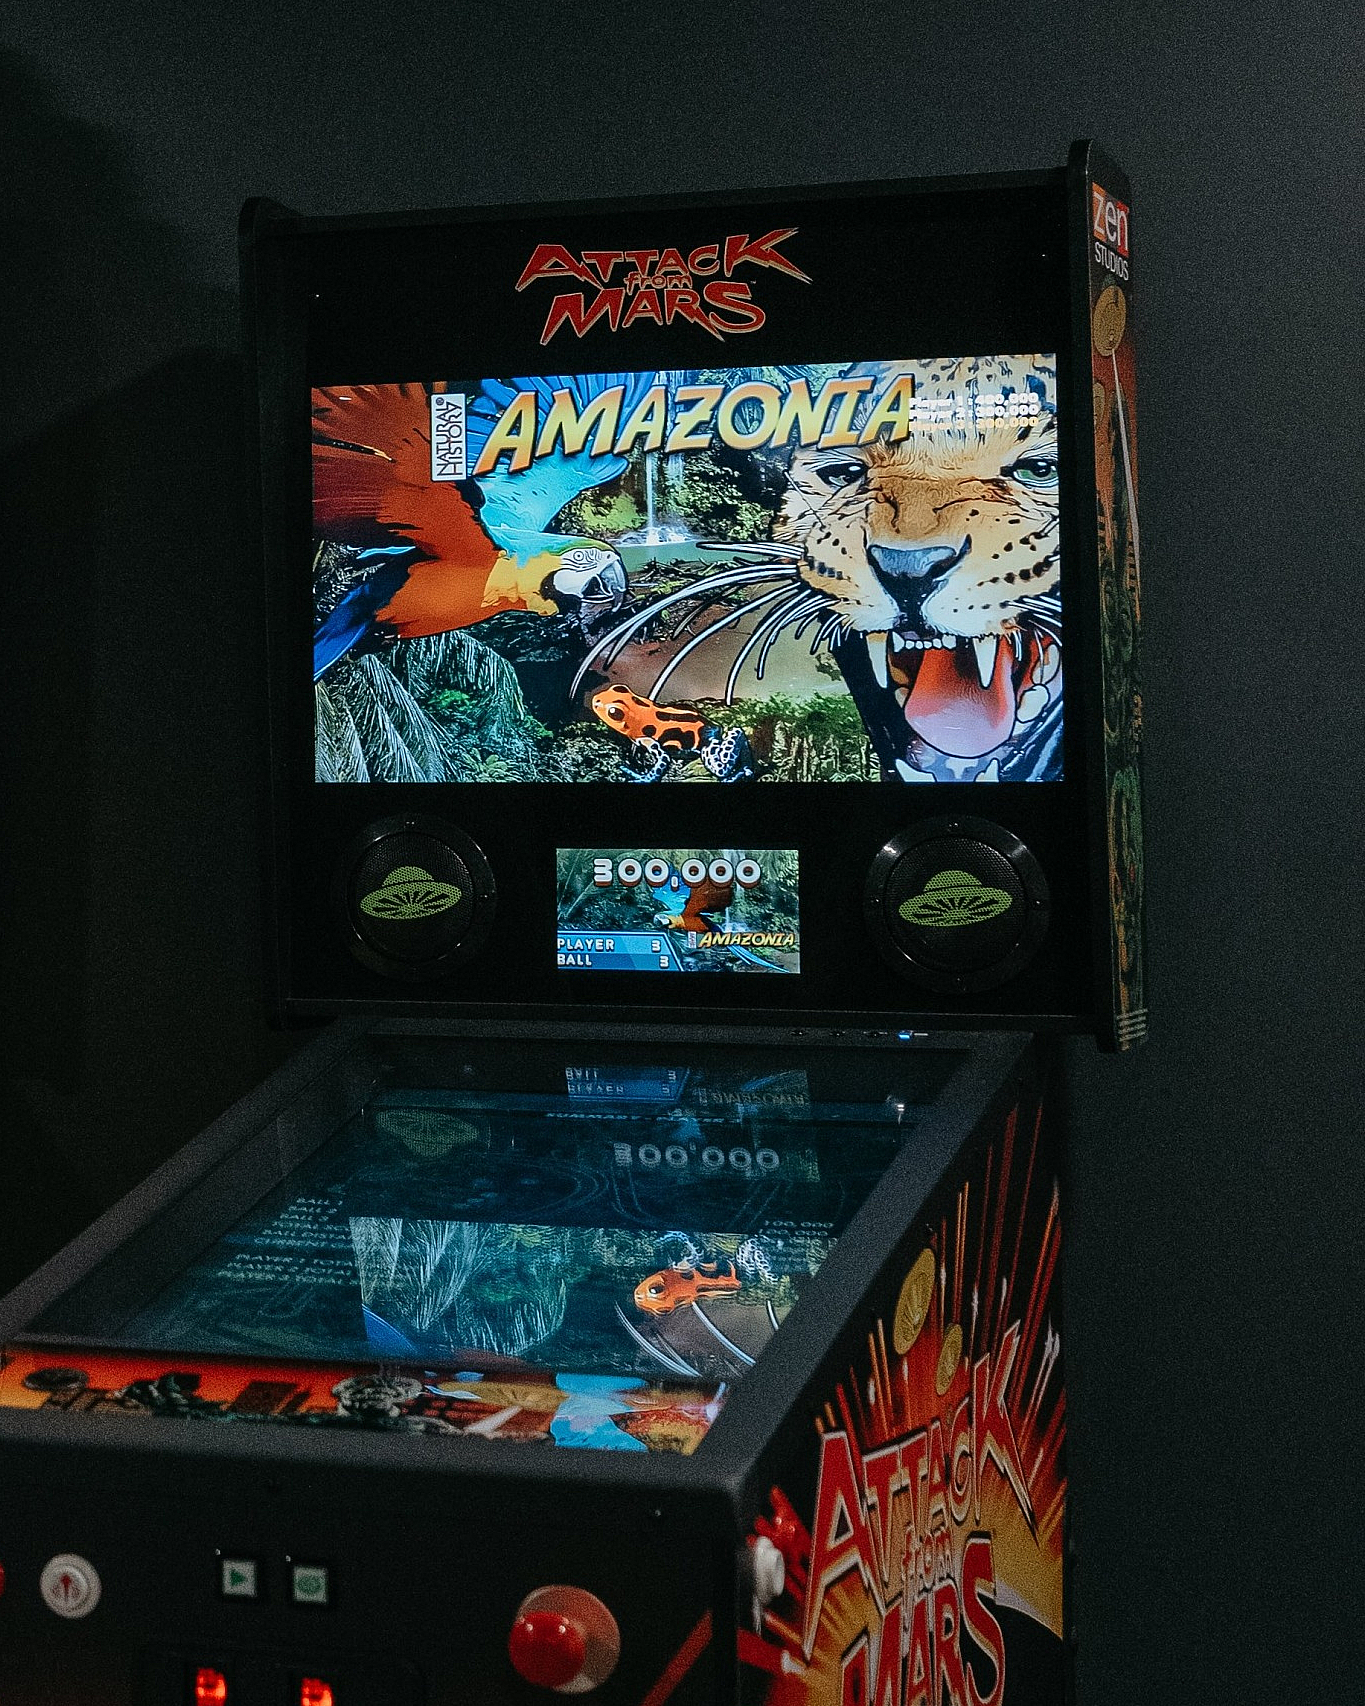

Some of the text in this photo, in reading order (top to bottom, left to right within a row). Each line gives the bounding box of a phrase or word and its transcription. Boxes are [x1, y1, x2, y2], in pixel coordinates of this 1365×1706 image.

[515, 227, 813, 291] ATTACK
[624, 271, 692, 295] from
[1094, 242, 1129, 281] STUDIOS
[540, 281, 765, 345] MARS
[448, 401, 463, 475] HISTORY
[472, 373, 916, 476] AMAZONIA
[593, 858, 761, 891] 300,000
[557, 939, 661, 952] PLAYER 3
[557, 953, 669, 968] BALL 3
[699, 932, 795, 948] AMAZONIA
[804, 1319, 1039, 1663] ATTACK
[901, 1525, 955, 1595] from
